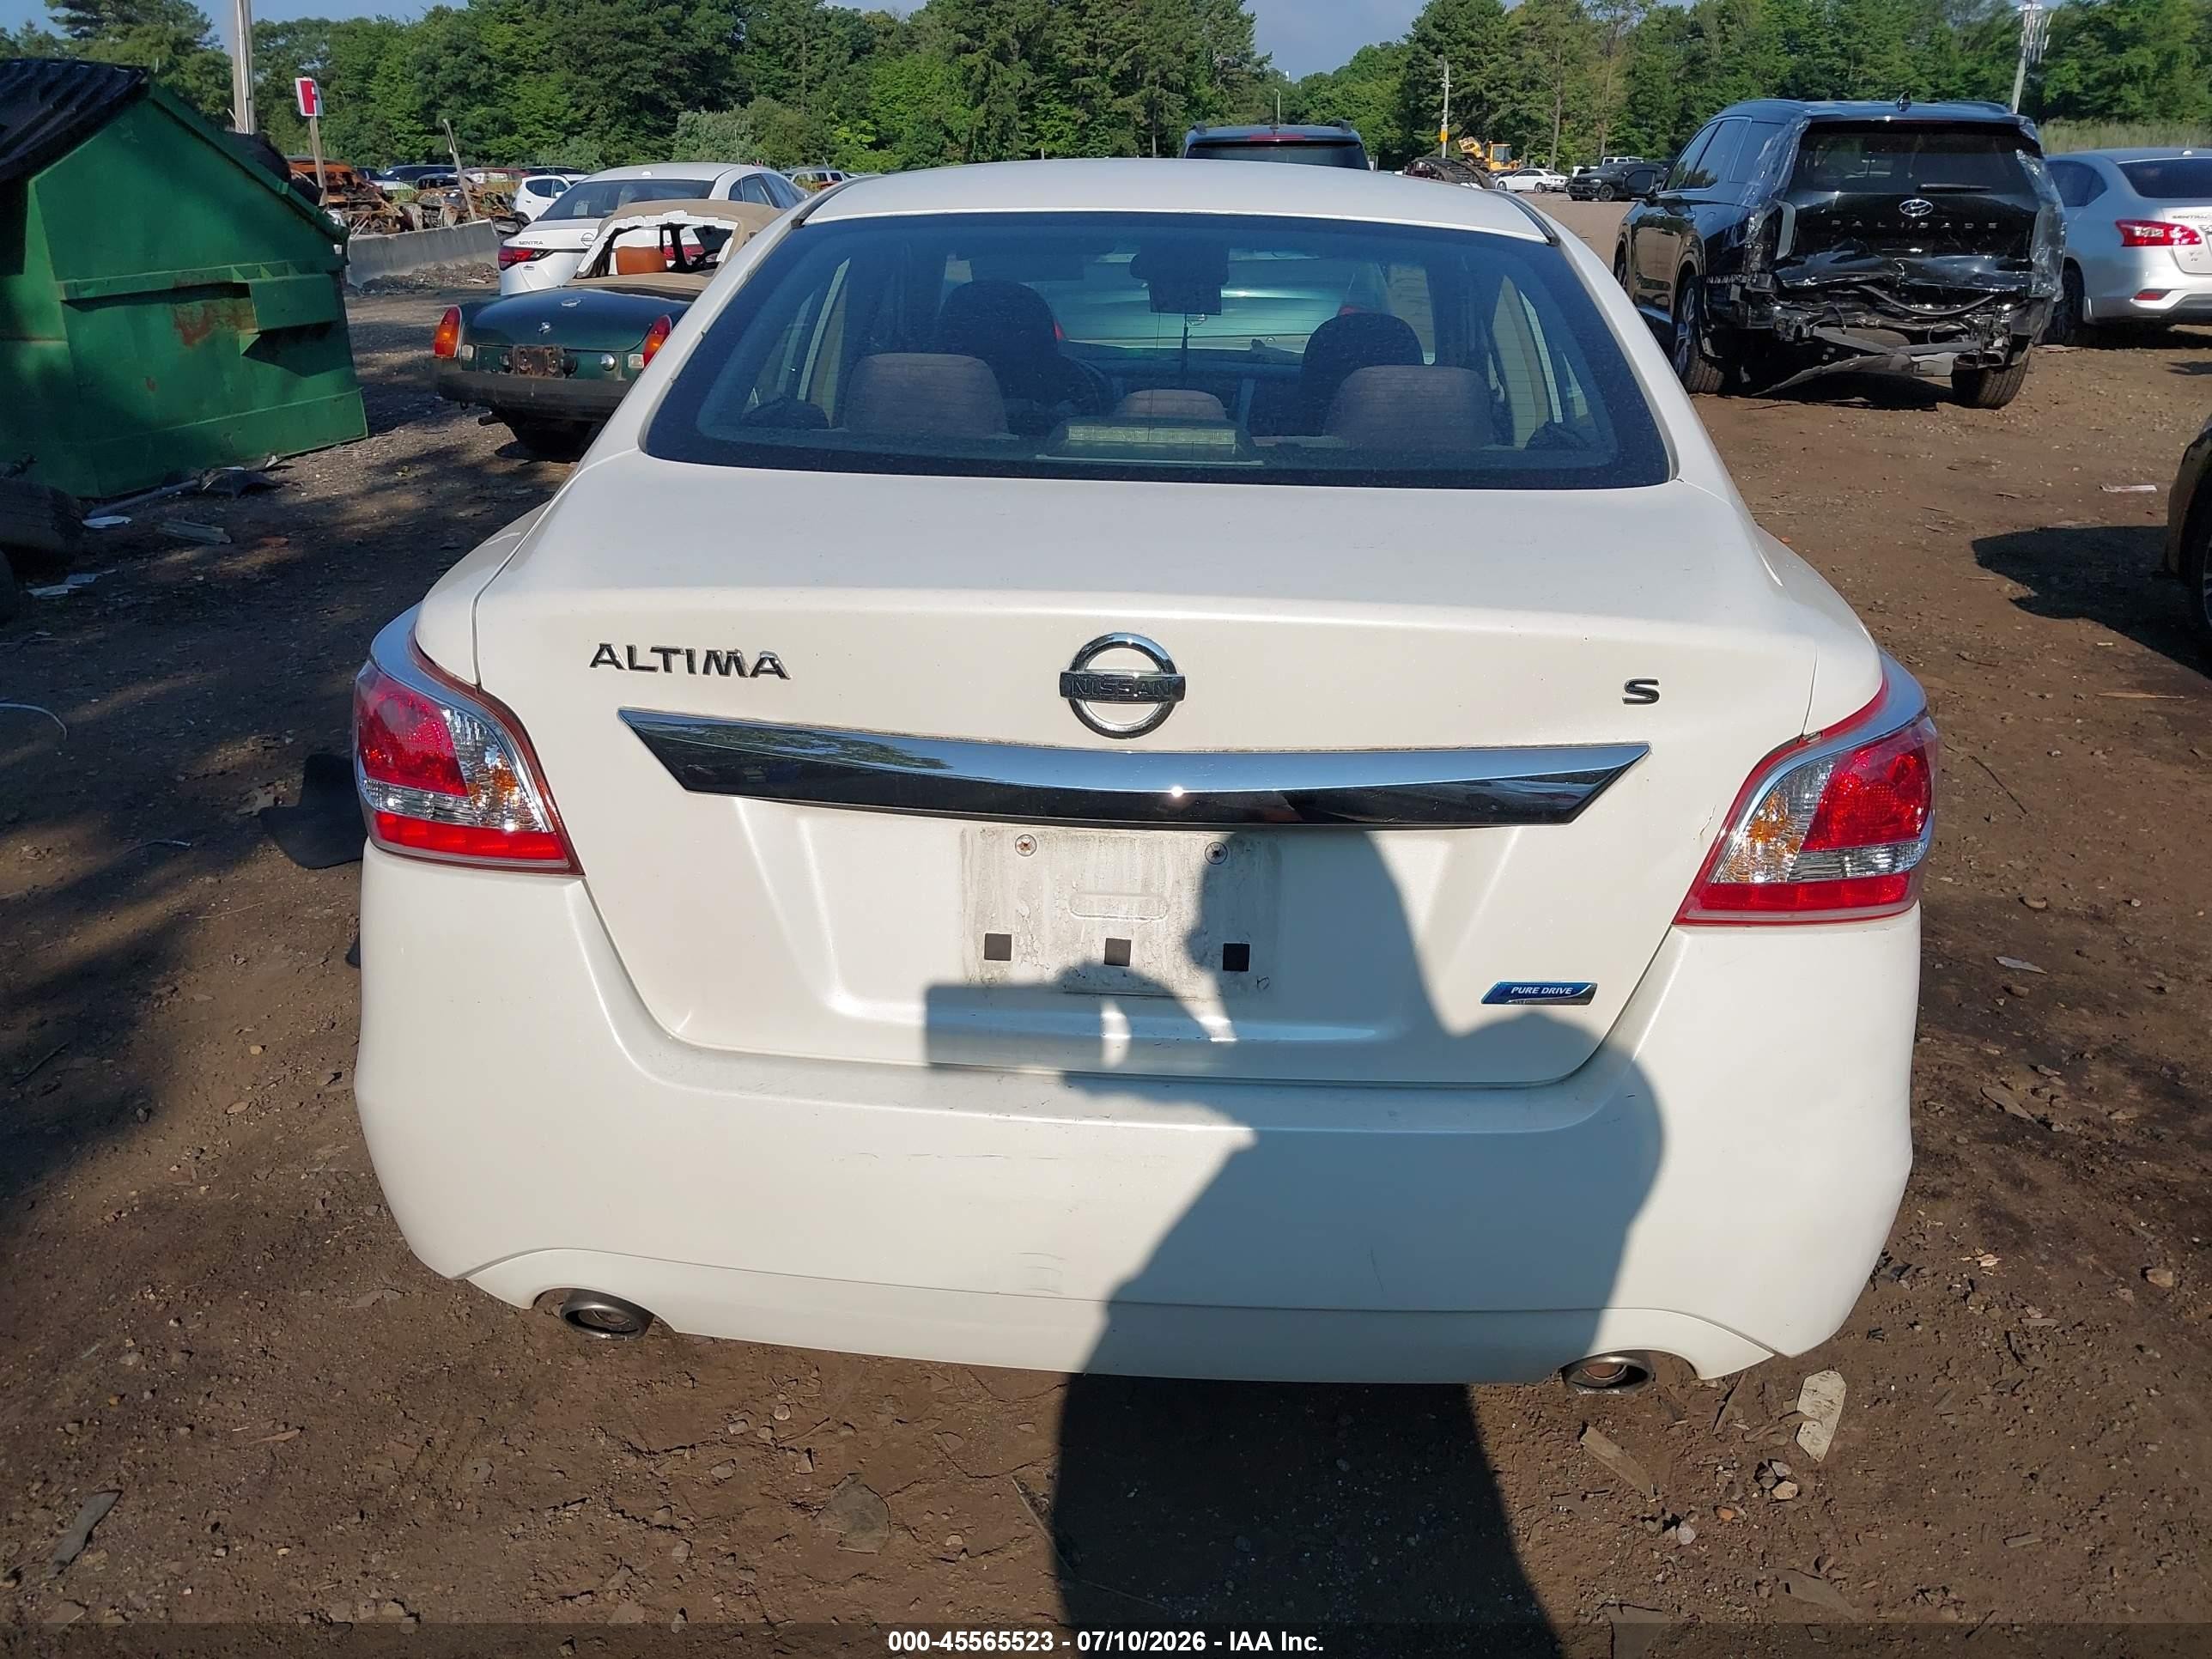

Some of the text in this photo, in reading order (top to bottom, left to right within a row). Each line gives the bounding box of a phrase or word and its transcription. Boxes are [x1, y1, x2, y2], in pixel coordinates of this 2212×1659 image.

[1832, 220, 1998, 229] PALISADE
[589, 642, 791, 680] ALTIMA
[1072, 673, 1170, 697] NISSAN
[1622, 678, 1660, 705] S
[1510, 986, 1573, 995] PURE DRIVE
